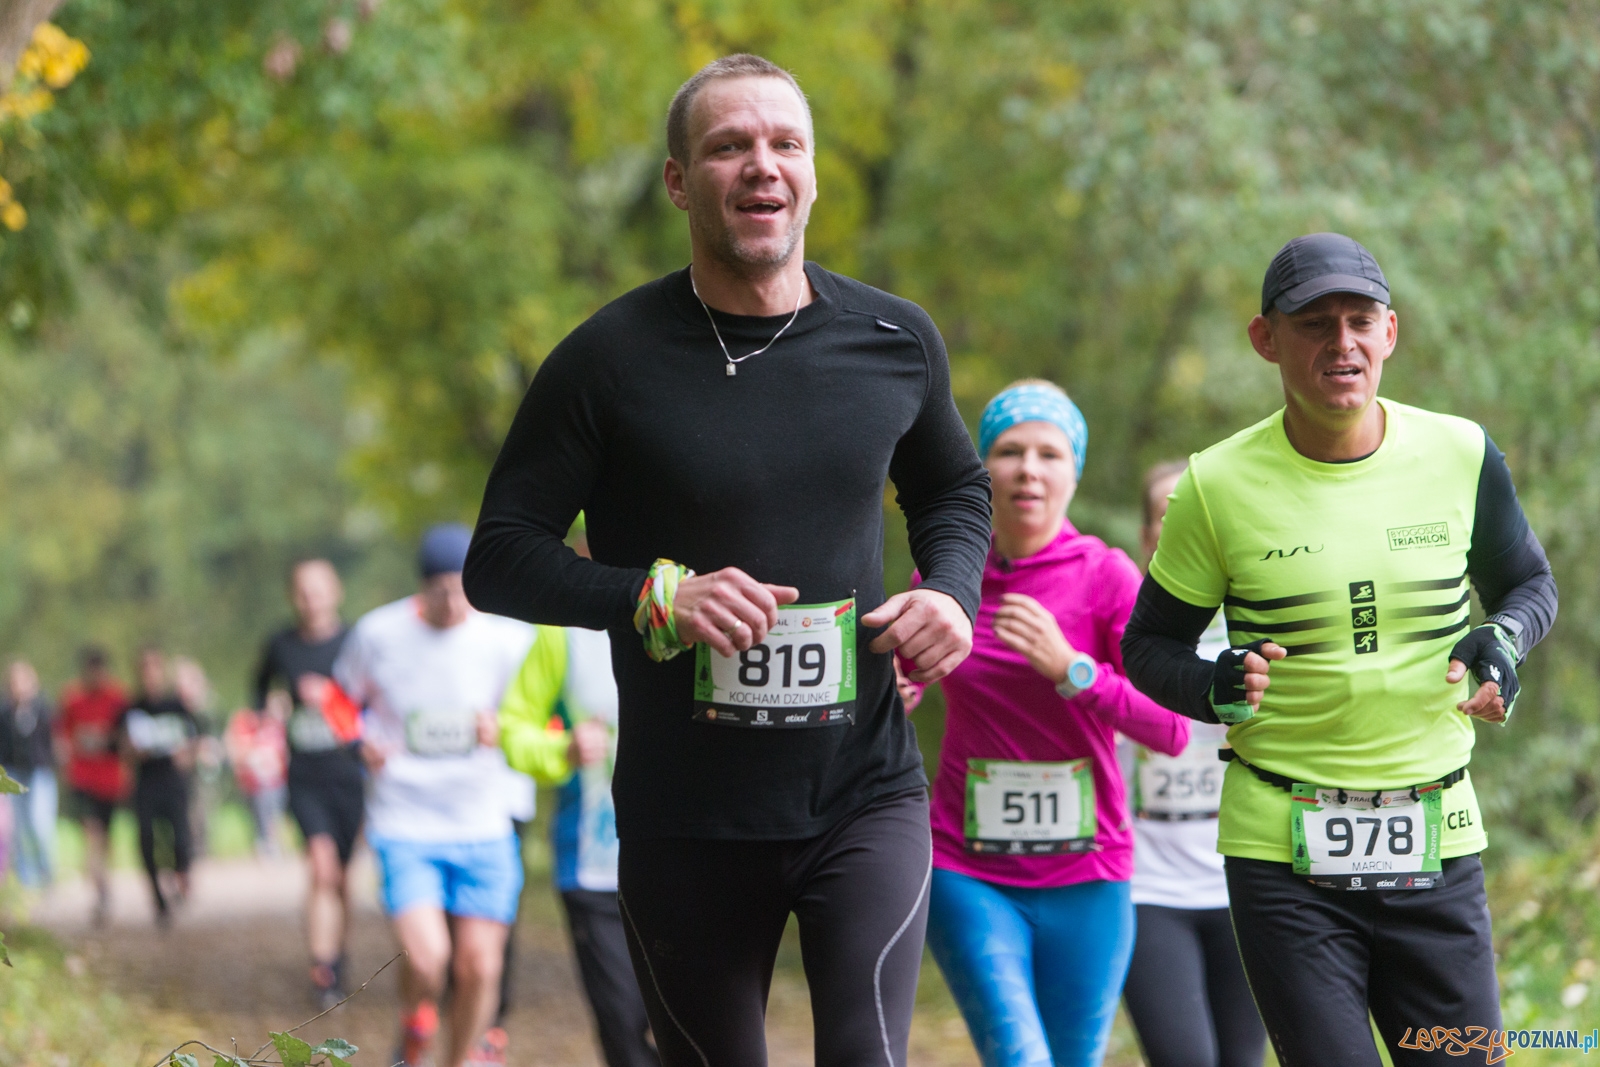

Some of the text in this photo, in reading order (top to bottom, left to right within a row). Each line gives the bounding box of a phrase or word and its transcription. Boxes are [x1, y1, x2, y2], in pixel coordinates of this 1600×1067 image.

[1390, 525, 1446, 538] BYDGOSZCZ
[1392, 533, 1448, 547] TRIATHLON
[738, 643, 826, 688] 819
[729, 691, 780, 705] KOCHAM
[1152, 767, 1217, 799] 256
[1002, 791, 1058, 825] 511
[1325, 815, 1413, 857] 978
[1428, 824, 1437, 860] Poznań
[1351, 861, 1393, 872] MARCIN
